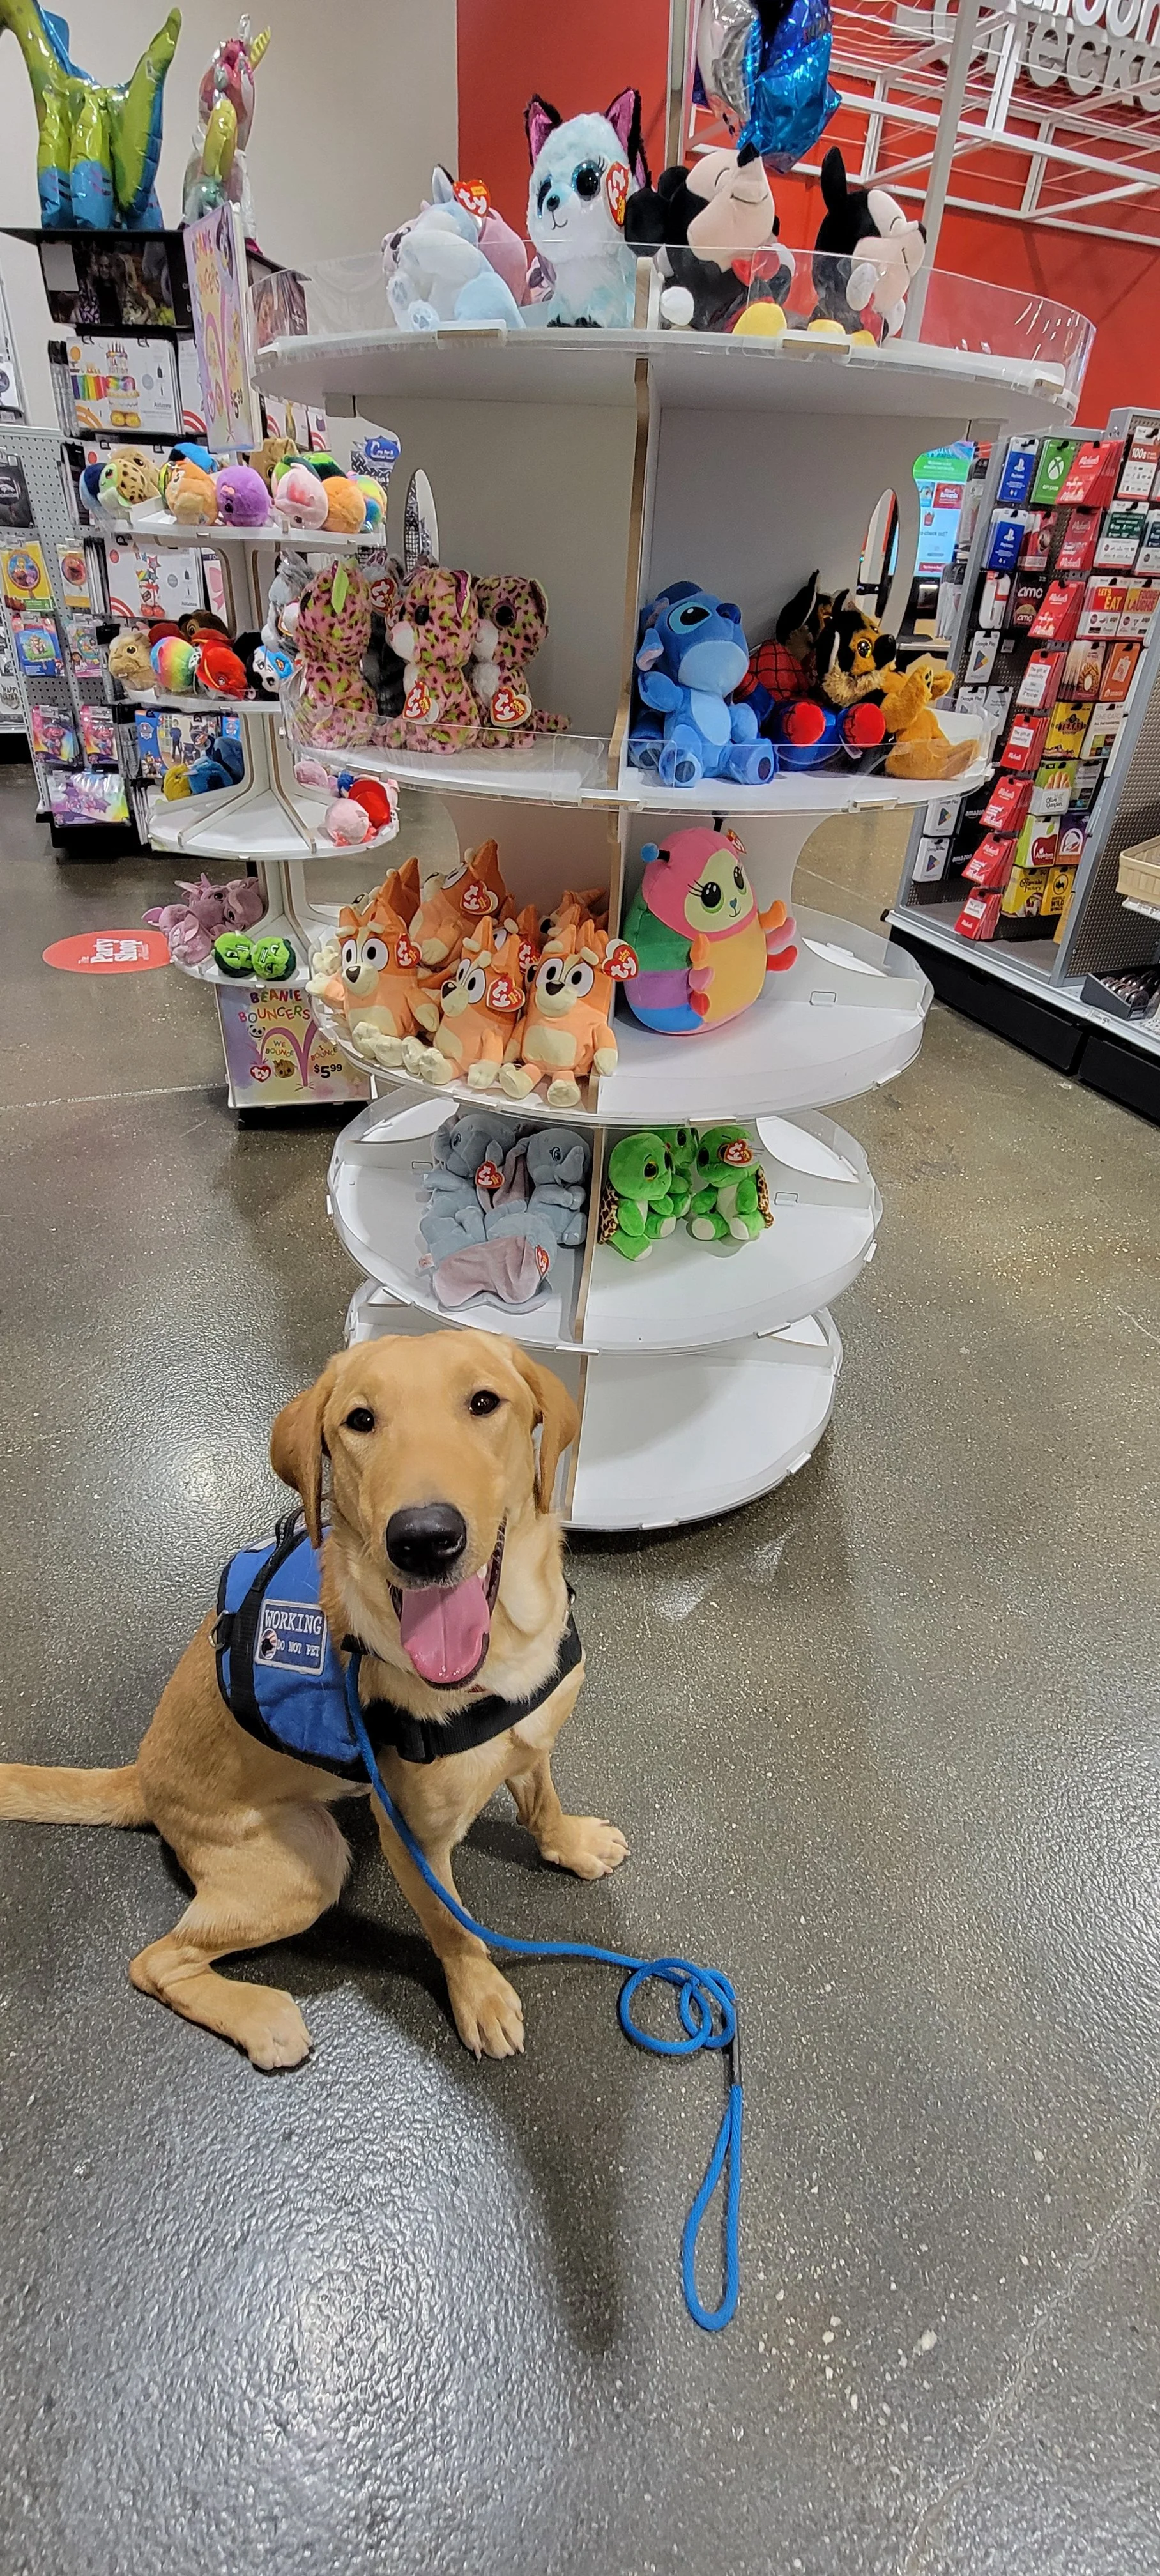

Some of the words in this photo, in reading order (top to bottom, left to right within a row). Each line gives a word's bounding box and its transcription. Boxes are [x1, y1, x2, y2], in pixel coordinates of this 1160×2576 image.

[609, 169, 625, 211] ty
[458, 190, 487, 214] ty
[371, 581, 390, 608] ty
[1104, 596, 1123, 611] EAT
[406, 688, 422, 719] ty
[495, 693, 515, 721] ty
[463, 884, 480, 910] ty
[90, 938, 120, 963] Party
[114, 939, 143, 962] Shop
[397, 940, 413, 967] ty
[610, 956, 637, 979] ty
[250, 988, 303, 1004] BEANIE
[492, 981, 511, 1008] ty
[238, 1005, 310, 1023] BOUNCERS
[264, 1047, 294, 1058] BOUNCE
[273, 1039, 286, 1048] WE
[310, 1046, 339, 1061] BOUNCE
[251, 1066, 270, 1080] ty
[726, 1142, 743, 1161] ty
[478, 1165, 493, 1186] ty
[538, 1250, 547, 1273] ty
[265, 1609, 323, 1635] WORKING
[277, 1639, 286, 1651] DO
[288, 1641, 302, 1654] NOT
[305, 1644, 321, 1657] PET
